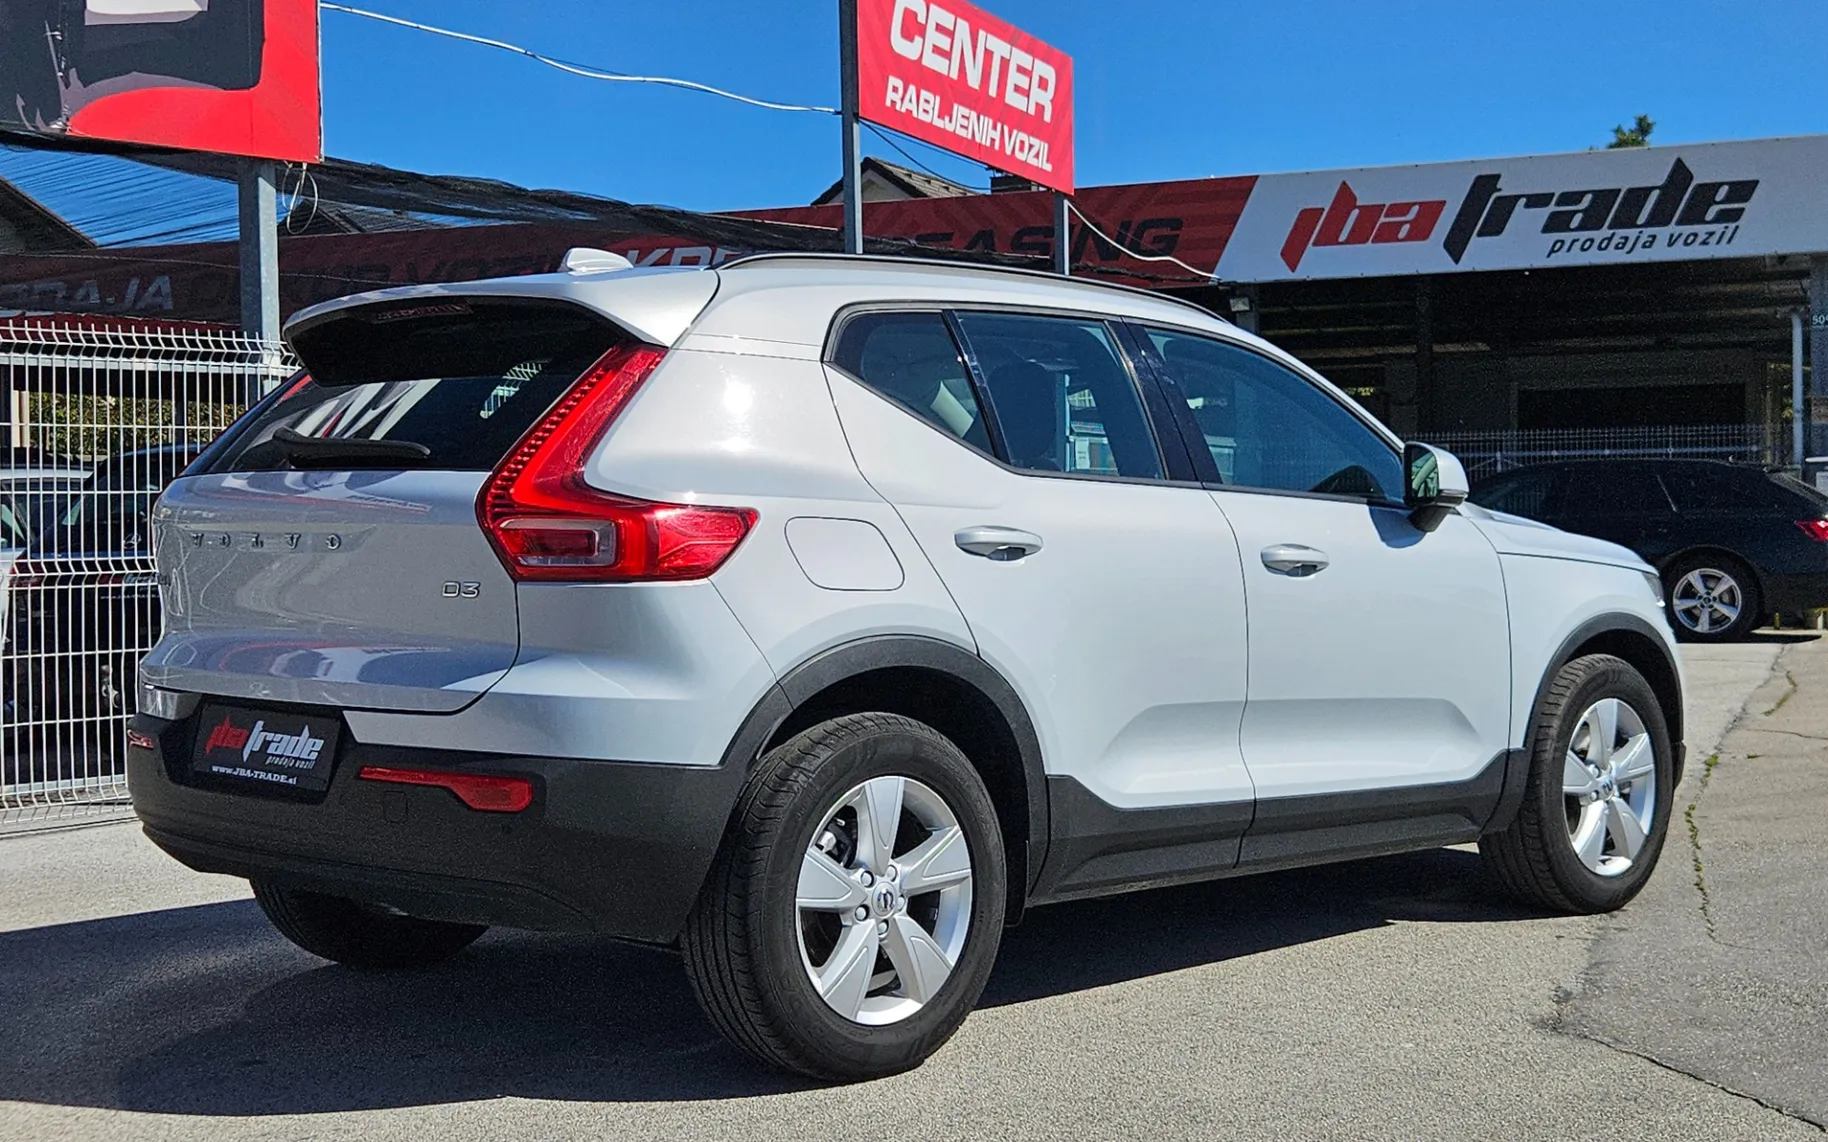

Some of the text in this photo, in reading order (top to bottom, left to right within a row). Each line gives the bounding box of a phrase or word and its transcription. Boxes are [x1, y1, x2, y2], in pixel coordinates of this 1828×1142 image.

[890, 0, 1056, 124] CENTER
[885, 75, 1053, 172] RABLJENIH VOZIL
[1443, 157, 1760, 265] trade
[1546, 225, 1740, 258] prodaja vozil
[442, 581, 481, 599] D3
[242, 720, 325, 763] trade
